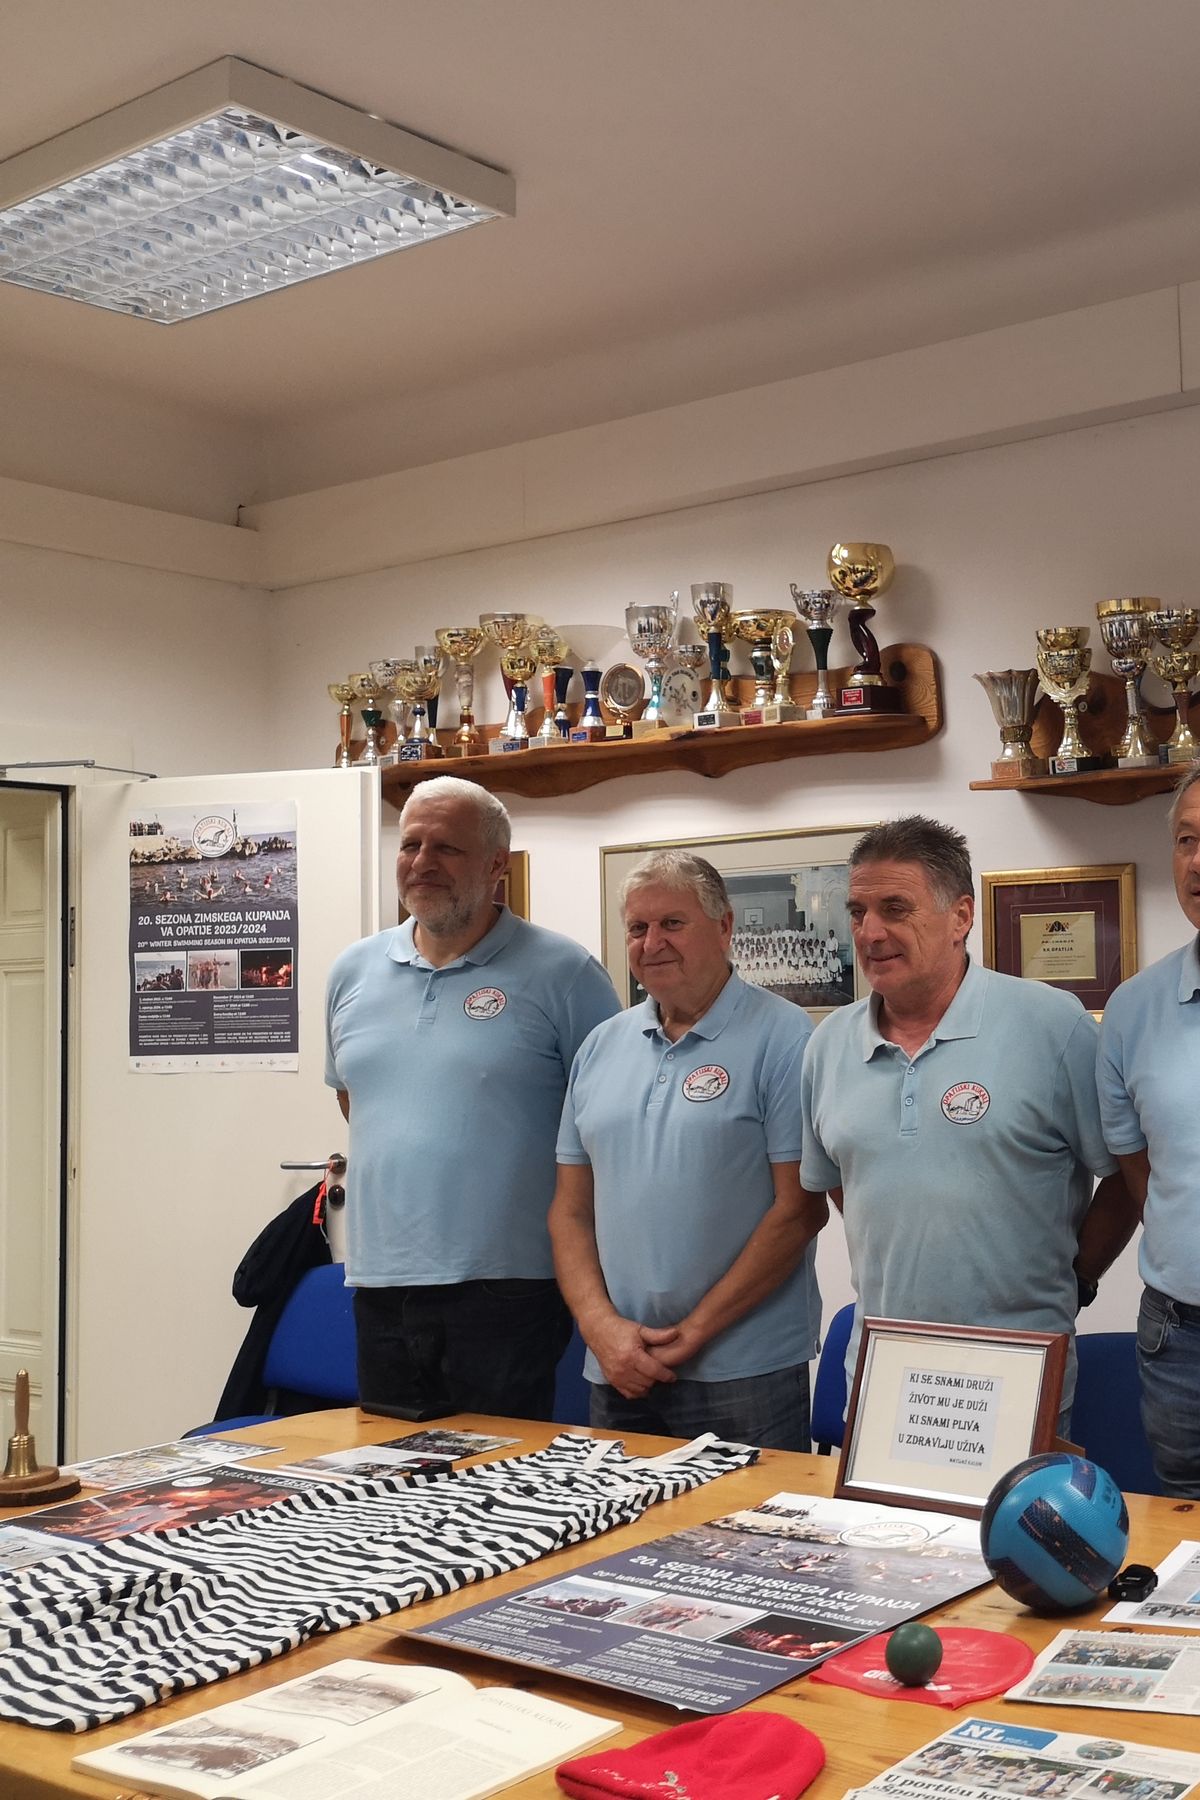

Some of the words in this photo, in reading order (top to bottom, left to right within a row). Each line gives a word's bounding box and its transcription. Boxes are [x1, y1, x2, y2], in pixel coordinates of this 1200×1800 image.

[138, 916, 153, 925] 20.
[155, 913, 192, 925] SEZONA
[194, 912, 243, 923] ZIMSKEGA
[245, 910, 291, 921] KUPANJA
[160, 927, 174, 936] VA
[176, 925, 212, 936] OPATIJE
[214, 924, 267, 935] 2023/2024
[234, 937, 257, 945] OPATIJA
[943, 1084, 970, 1105] OPATIJSKI
[909, 1373, 920, 1383] KI
[921, 1374, 933, 1385] SE
[934, 1376, 965, 1388] SNAMI
[966, 1378, 994, 1392] DRUŽI
[908, 1391, 936, 1406] ŽIVOT
[937, 1397, 950, 1408] MU
[952, 1399, 965, 1409] JE
[966, 1399, 988, 1412] DUŽI
[908, 1414, 920, 1424] KI
[920, 1415, 950, 1428] SNAMI
[952, 1419, 980, 1432] PLIVA
[898, 1433, 904, 1443] U
[905, 1434, 955, 1449] ZDRAVLJU
[956, 1440, 985, 1454] UŽIVA
[629, 1555, 658, 1567] 20.
[660, 1561, 734, 1580] SEZONA
[731, 1574, 830, 1596] ZIMSKEGA
[829, 1590, 921, 1611] KUPANJA
[653, 1570, 678, 1581] VA
[678, 1571, 756, 1594] OPATIJE
[751, 1588, 860, 1612] 2023/2024
[615, 1574, 657, 1586] WINTER
[655, 1581, 716, 1597] SWIMMING
[714, 1590, 760, 1606] SEASON
[760, 1599, 775, 1608] IN
[774, 1602, 821, 1616] OPATIJA
[819, 1610, 887, 1627] 2023/2024
[959, 1724, 1005, 1743] NL
[884, 1774, 897, 1783] U
[900, 1776, 973, 1797] portiću
